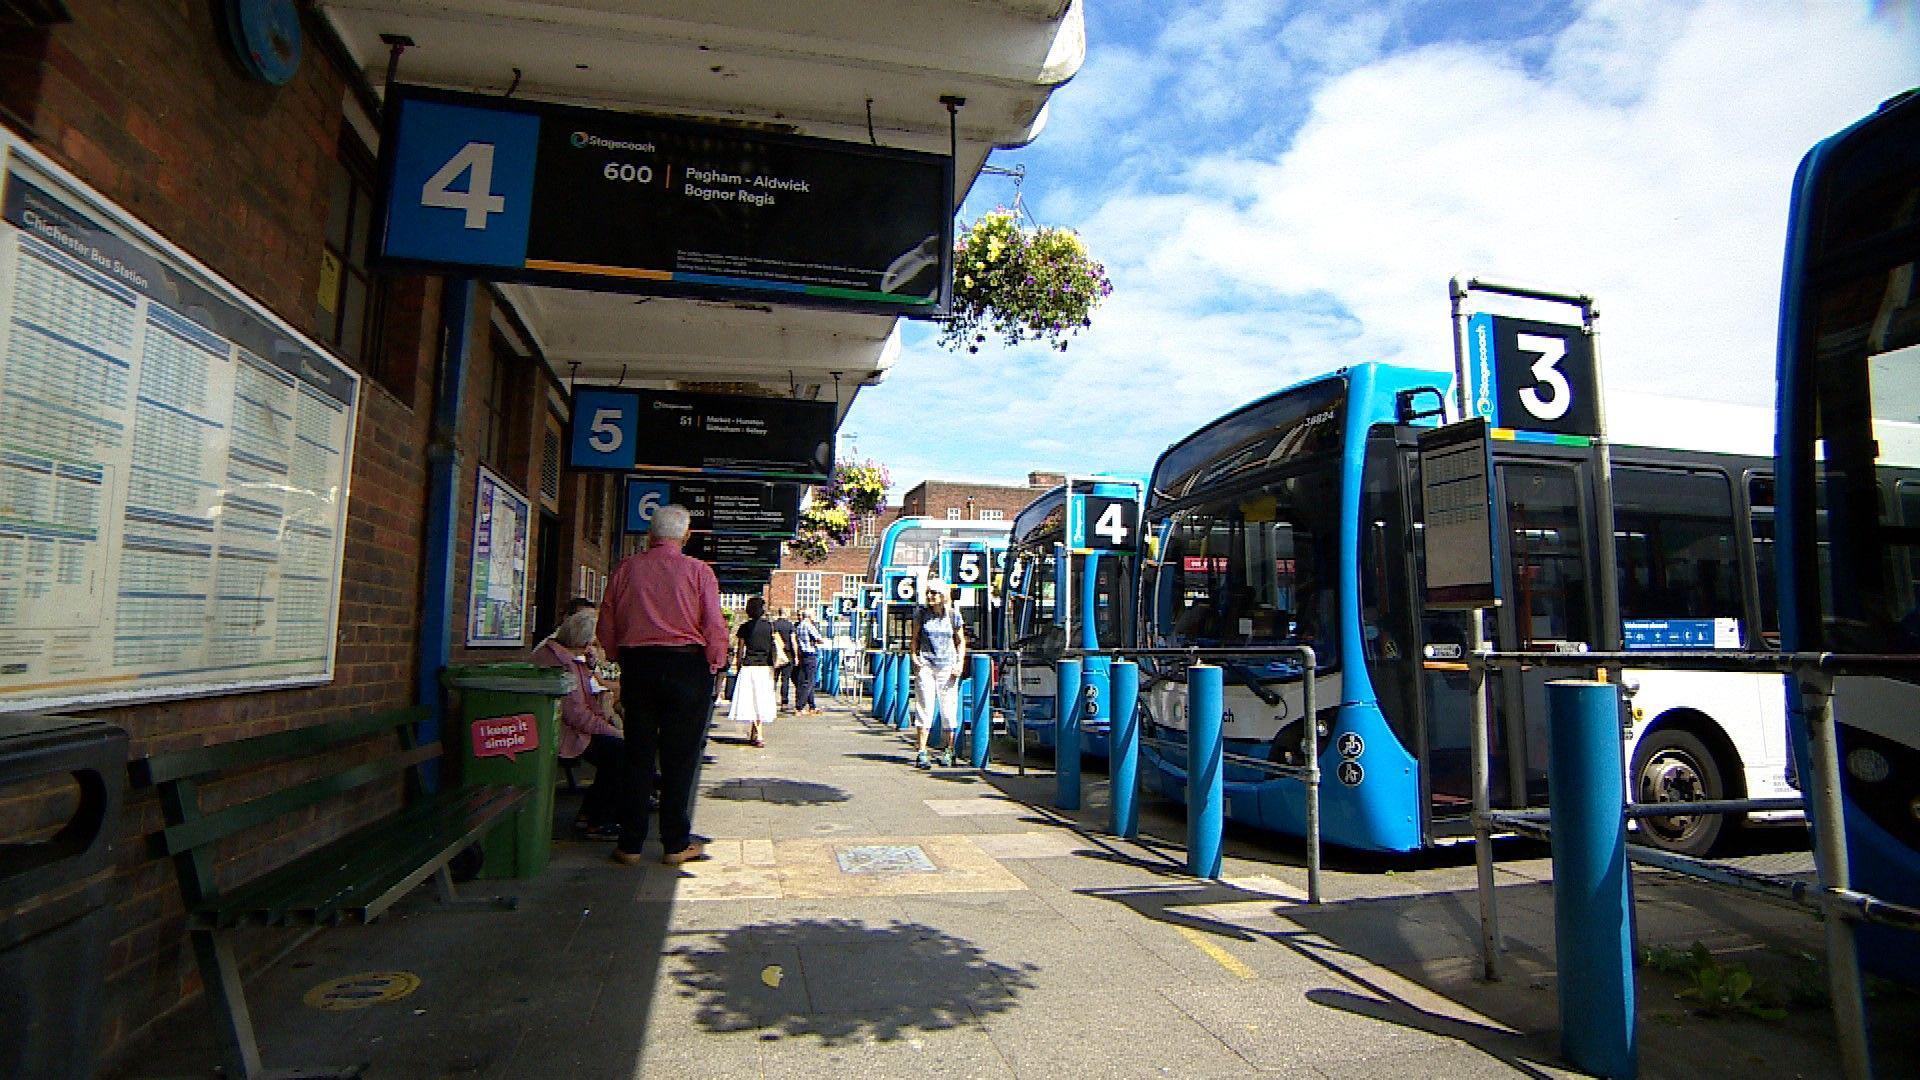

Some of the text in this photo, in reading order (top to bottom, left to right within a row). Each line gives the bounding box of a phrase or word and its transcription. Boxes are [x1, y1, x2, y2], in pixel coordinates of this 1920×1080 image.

[588, 135, 656, 153] Stagecoach
[421, 141, 505, 230] 4
[603, 161, 653, 184] 600
[685, 167, 742, 186] Pagham
[753, 175, 810, 193] Aldwick
[684, 183, 775, 207] Bognor Regis
[23, 209, 89, 257] Chichester
[91, 248, 111, 269] Bus
[112, 259, 148, 289] Station
[1475, 324, 1491, 398] Stagecoach
[1516, 331, 1572, 421] 3
[588, 408, 623, 453] 5
[638, 491, 662, 522] 6
[1095, 502, 1128, 545] 4
[959, 555, 980, 582] 5
[870, 591, 882, 608] 7
[897, 577, 914, 599] 6
[480, 720, 528, 737] I keep it
[484, 734, 525, 747] simple
